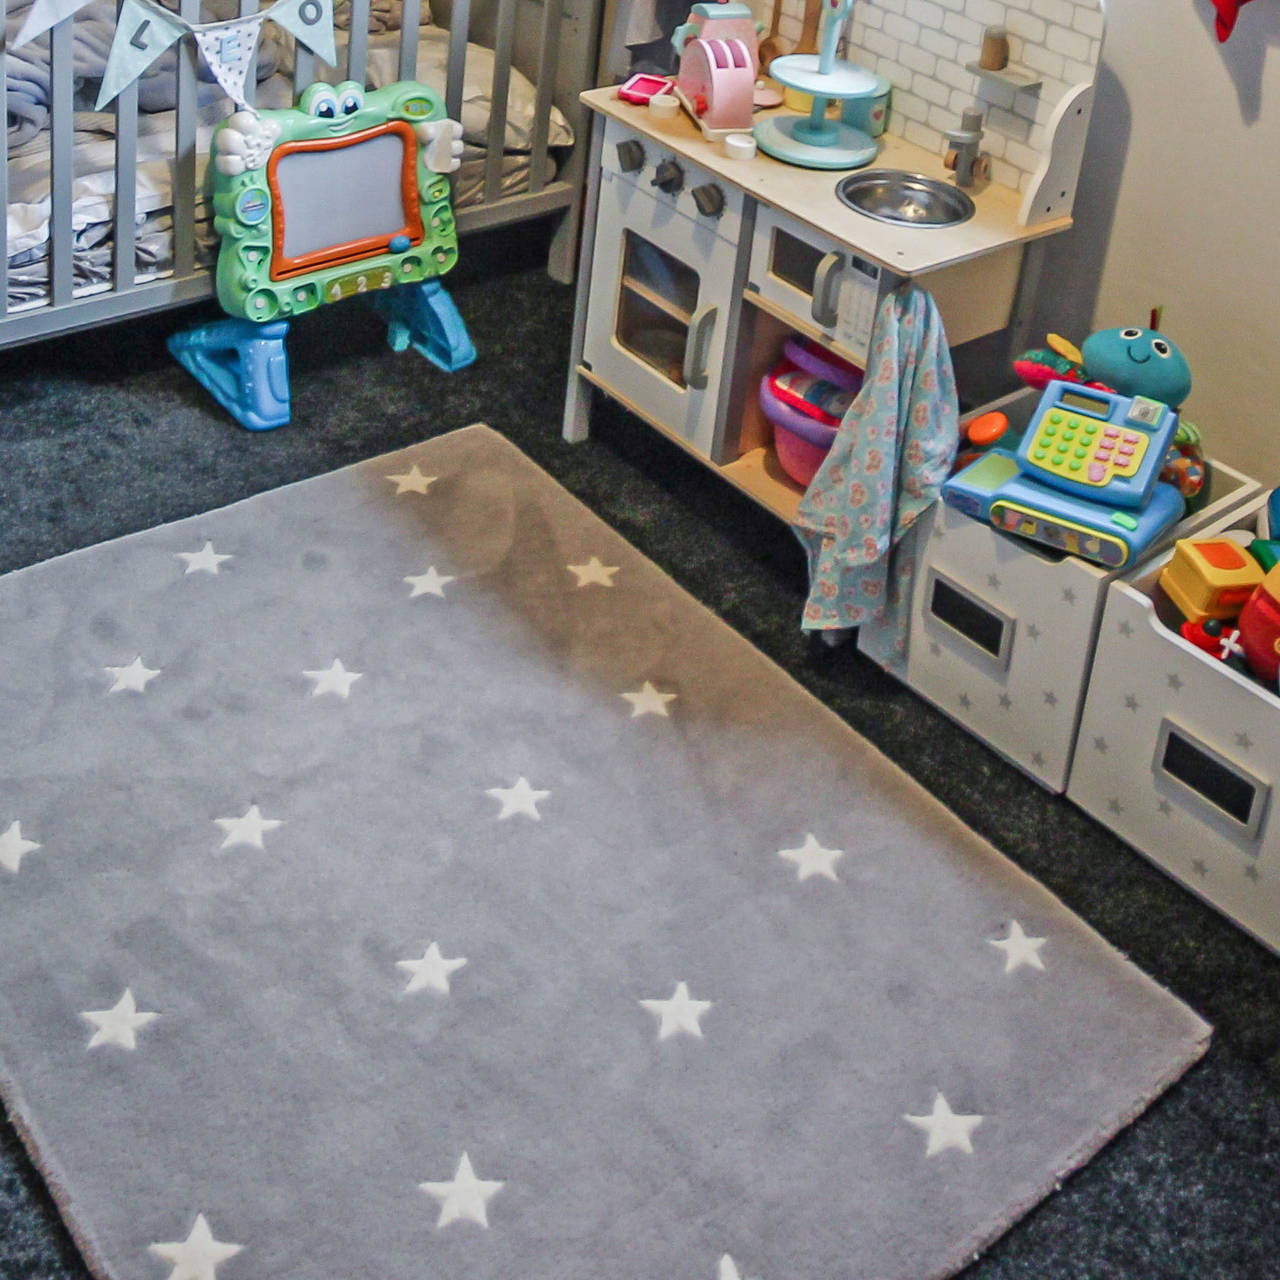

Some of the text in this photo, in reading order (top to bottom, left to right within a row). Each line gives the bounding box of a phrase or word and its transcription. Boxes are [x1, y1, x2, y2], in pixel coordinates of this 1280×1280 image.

[129, 19, 151, 51] L
[220, 34, 241, 64] E
[357, 276, 368, 293] 2
[380, 271, 393, 289] 3
